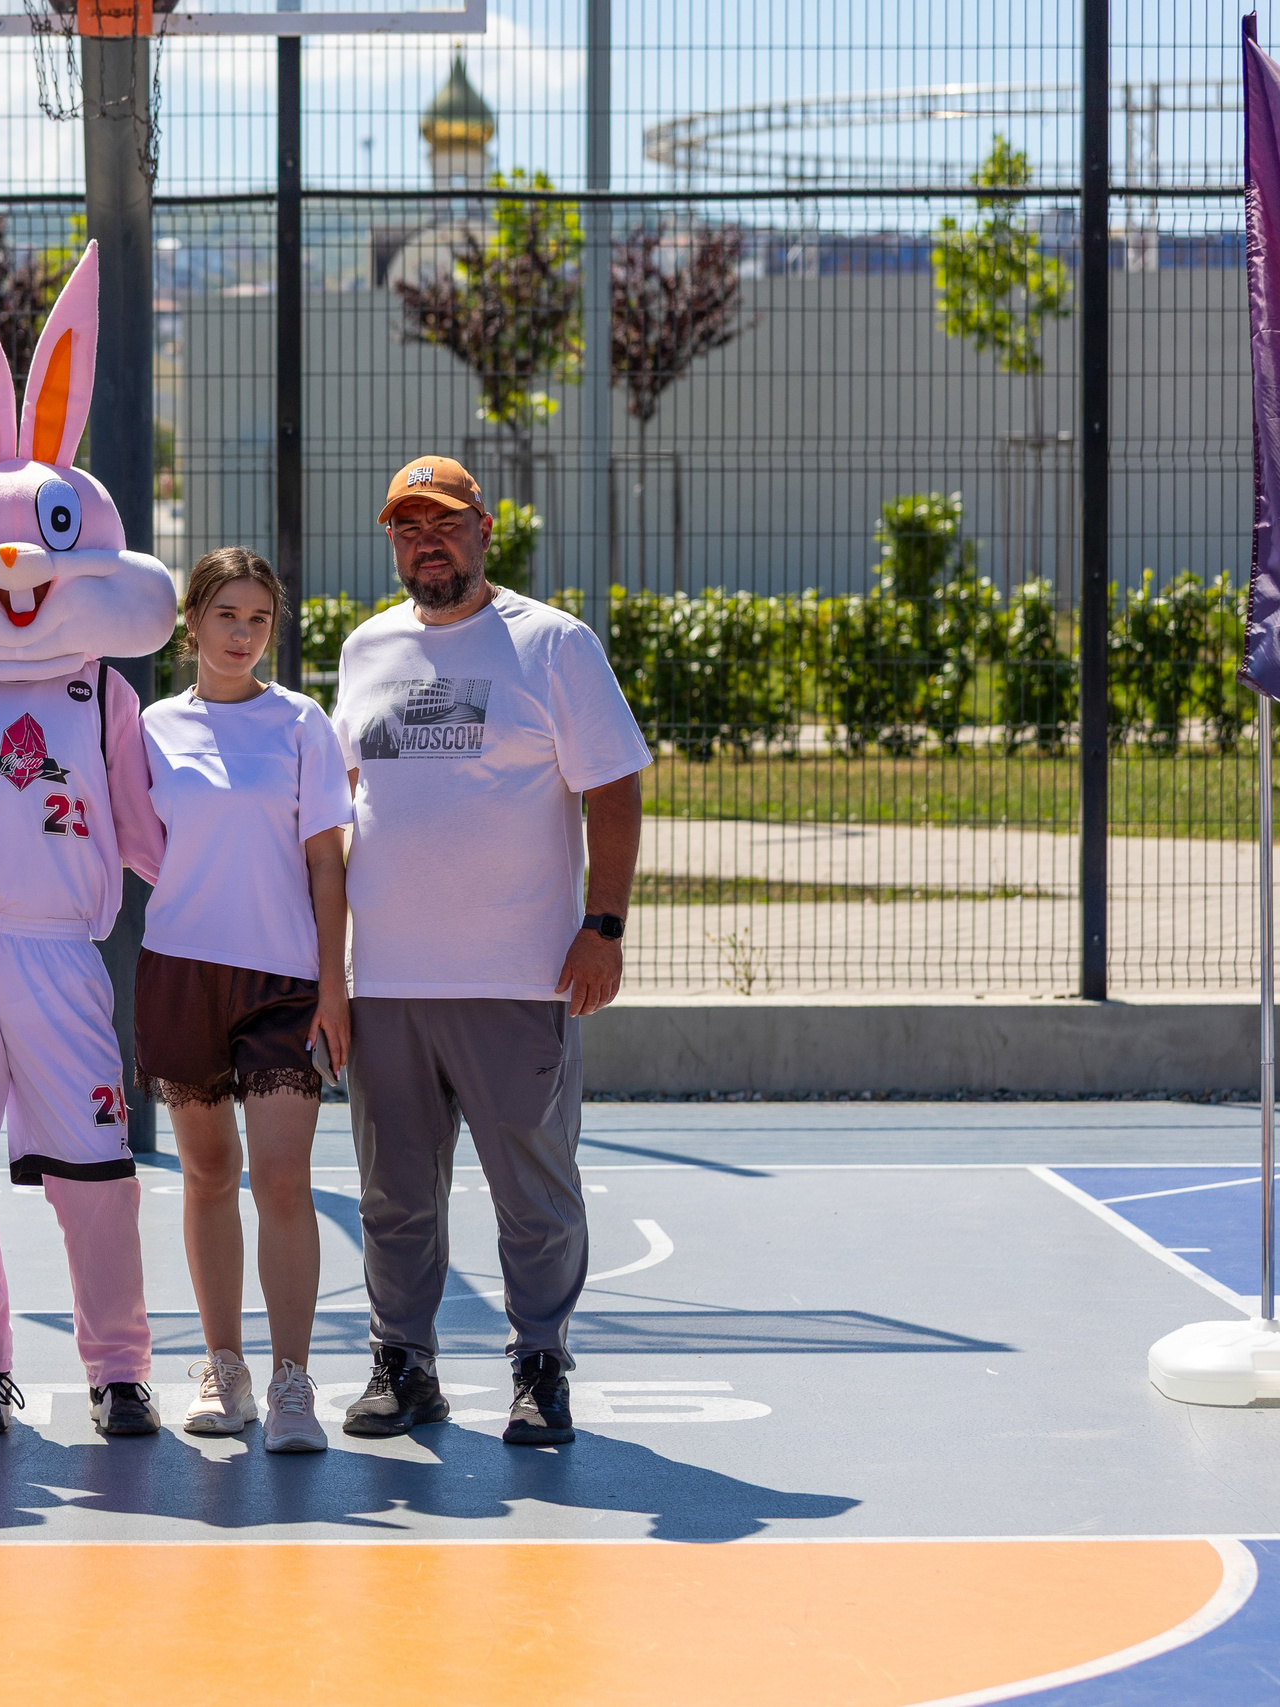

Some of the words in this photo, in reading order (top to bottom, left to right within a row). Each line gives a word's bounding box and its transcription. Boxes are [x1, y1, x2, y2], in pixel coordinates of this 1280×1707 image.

[408, 466, 434, 477] NEW
[407, 474, 433, 487] ERA
[69, 686, 90, 696] РФБ
[400, 726, 485, 750] MOSCOW
